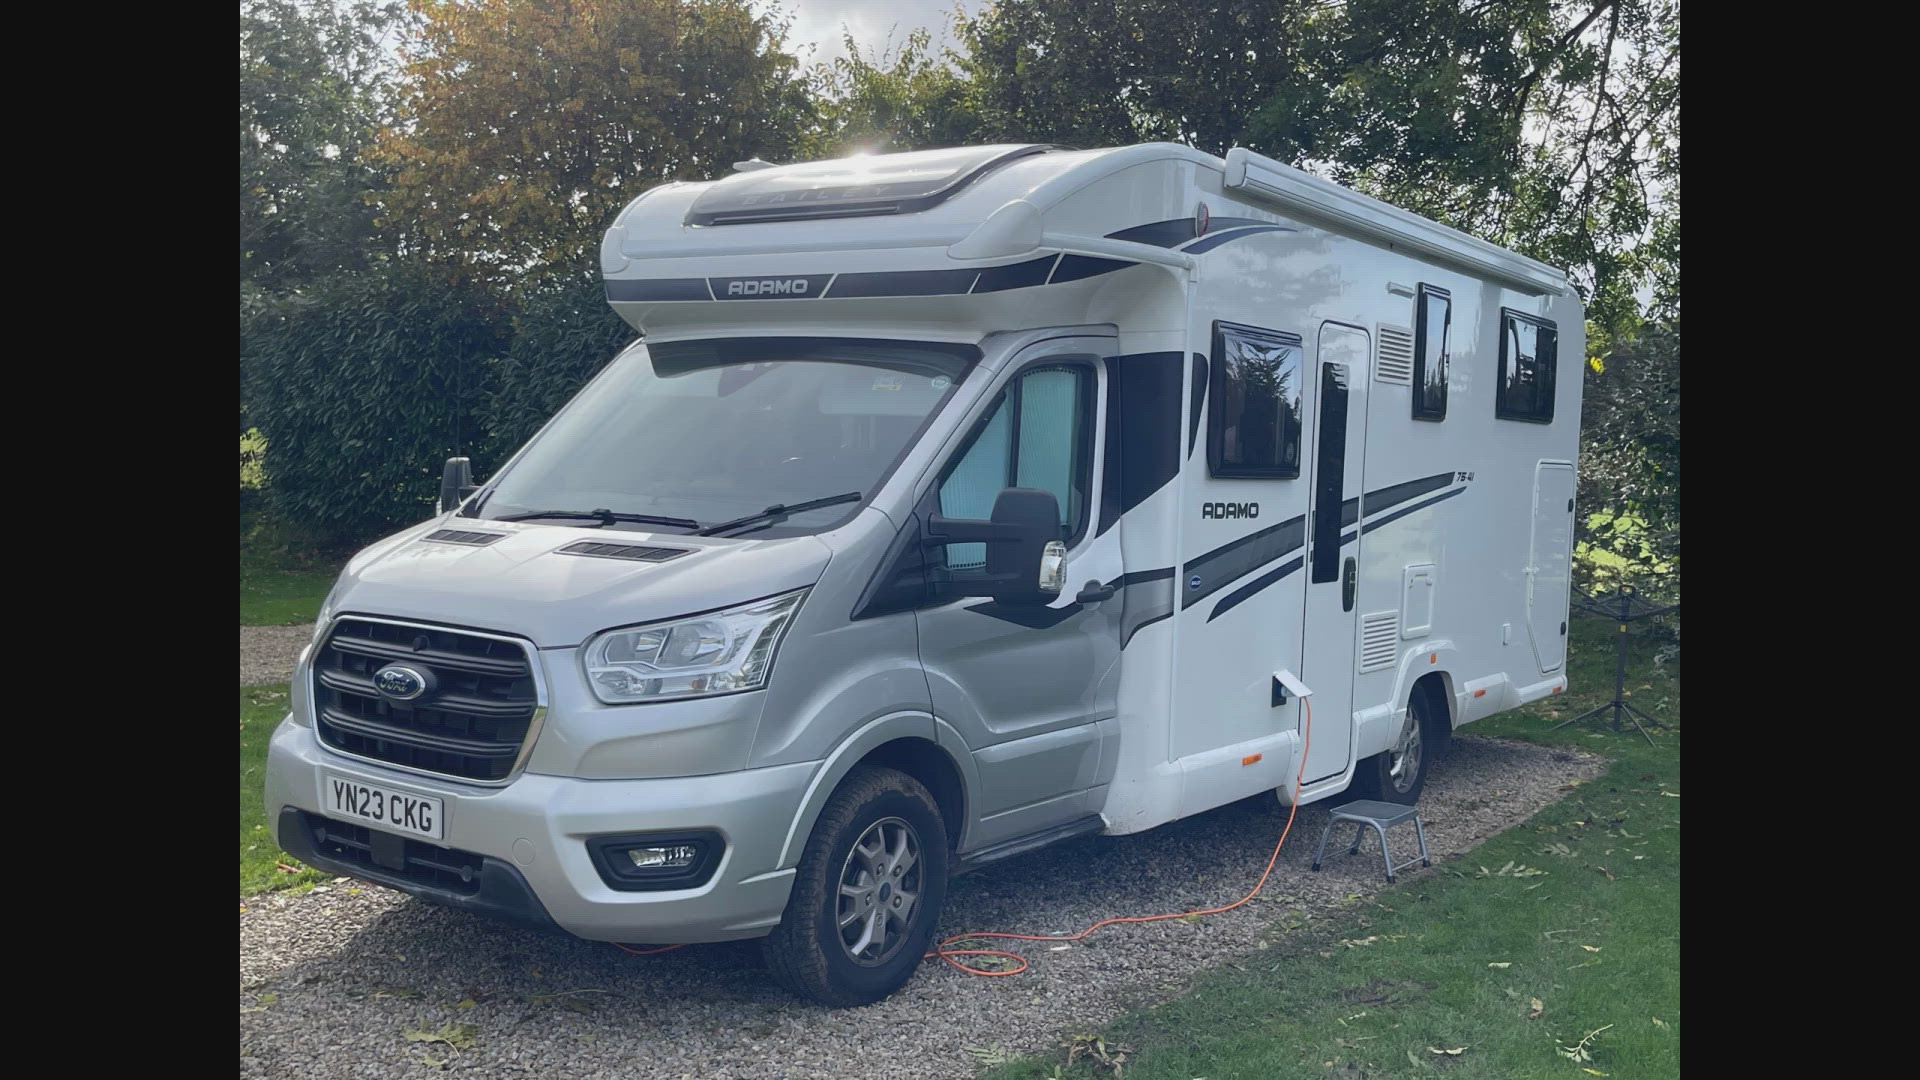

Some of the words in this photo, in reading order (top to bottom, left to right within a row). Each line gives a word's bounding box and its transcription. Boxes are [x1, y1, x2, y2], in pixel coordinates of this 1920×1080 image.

[727, 279, 809, 296] ADAMO
[1202, 502, 1260, 520] ADAMO
[380, 670, 410, 692] Ford
[333, 779, 384, 820] YN23
[390, 794, 432, 832] CKG
